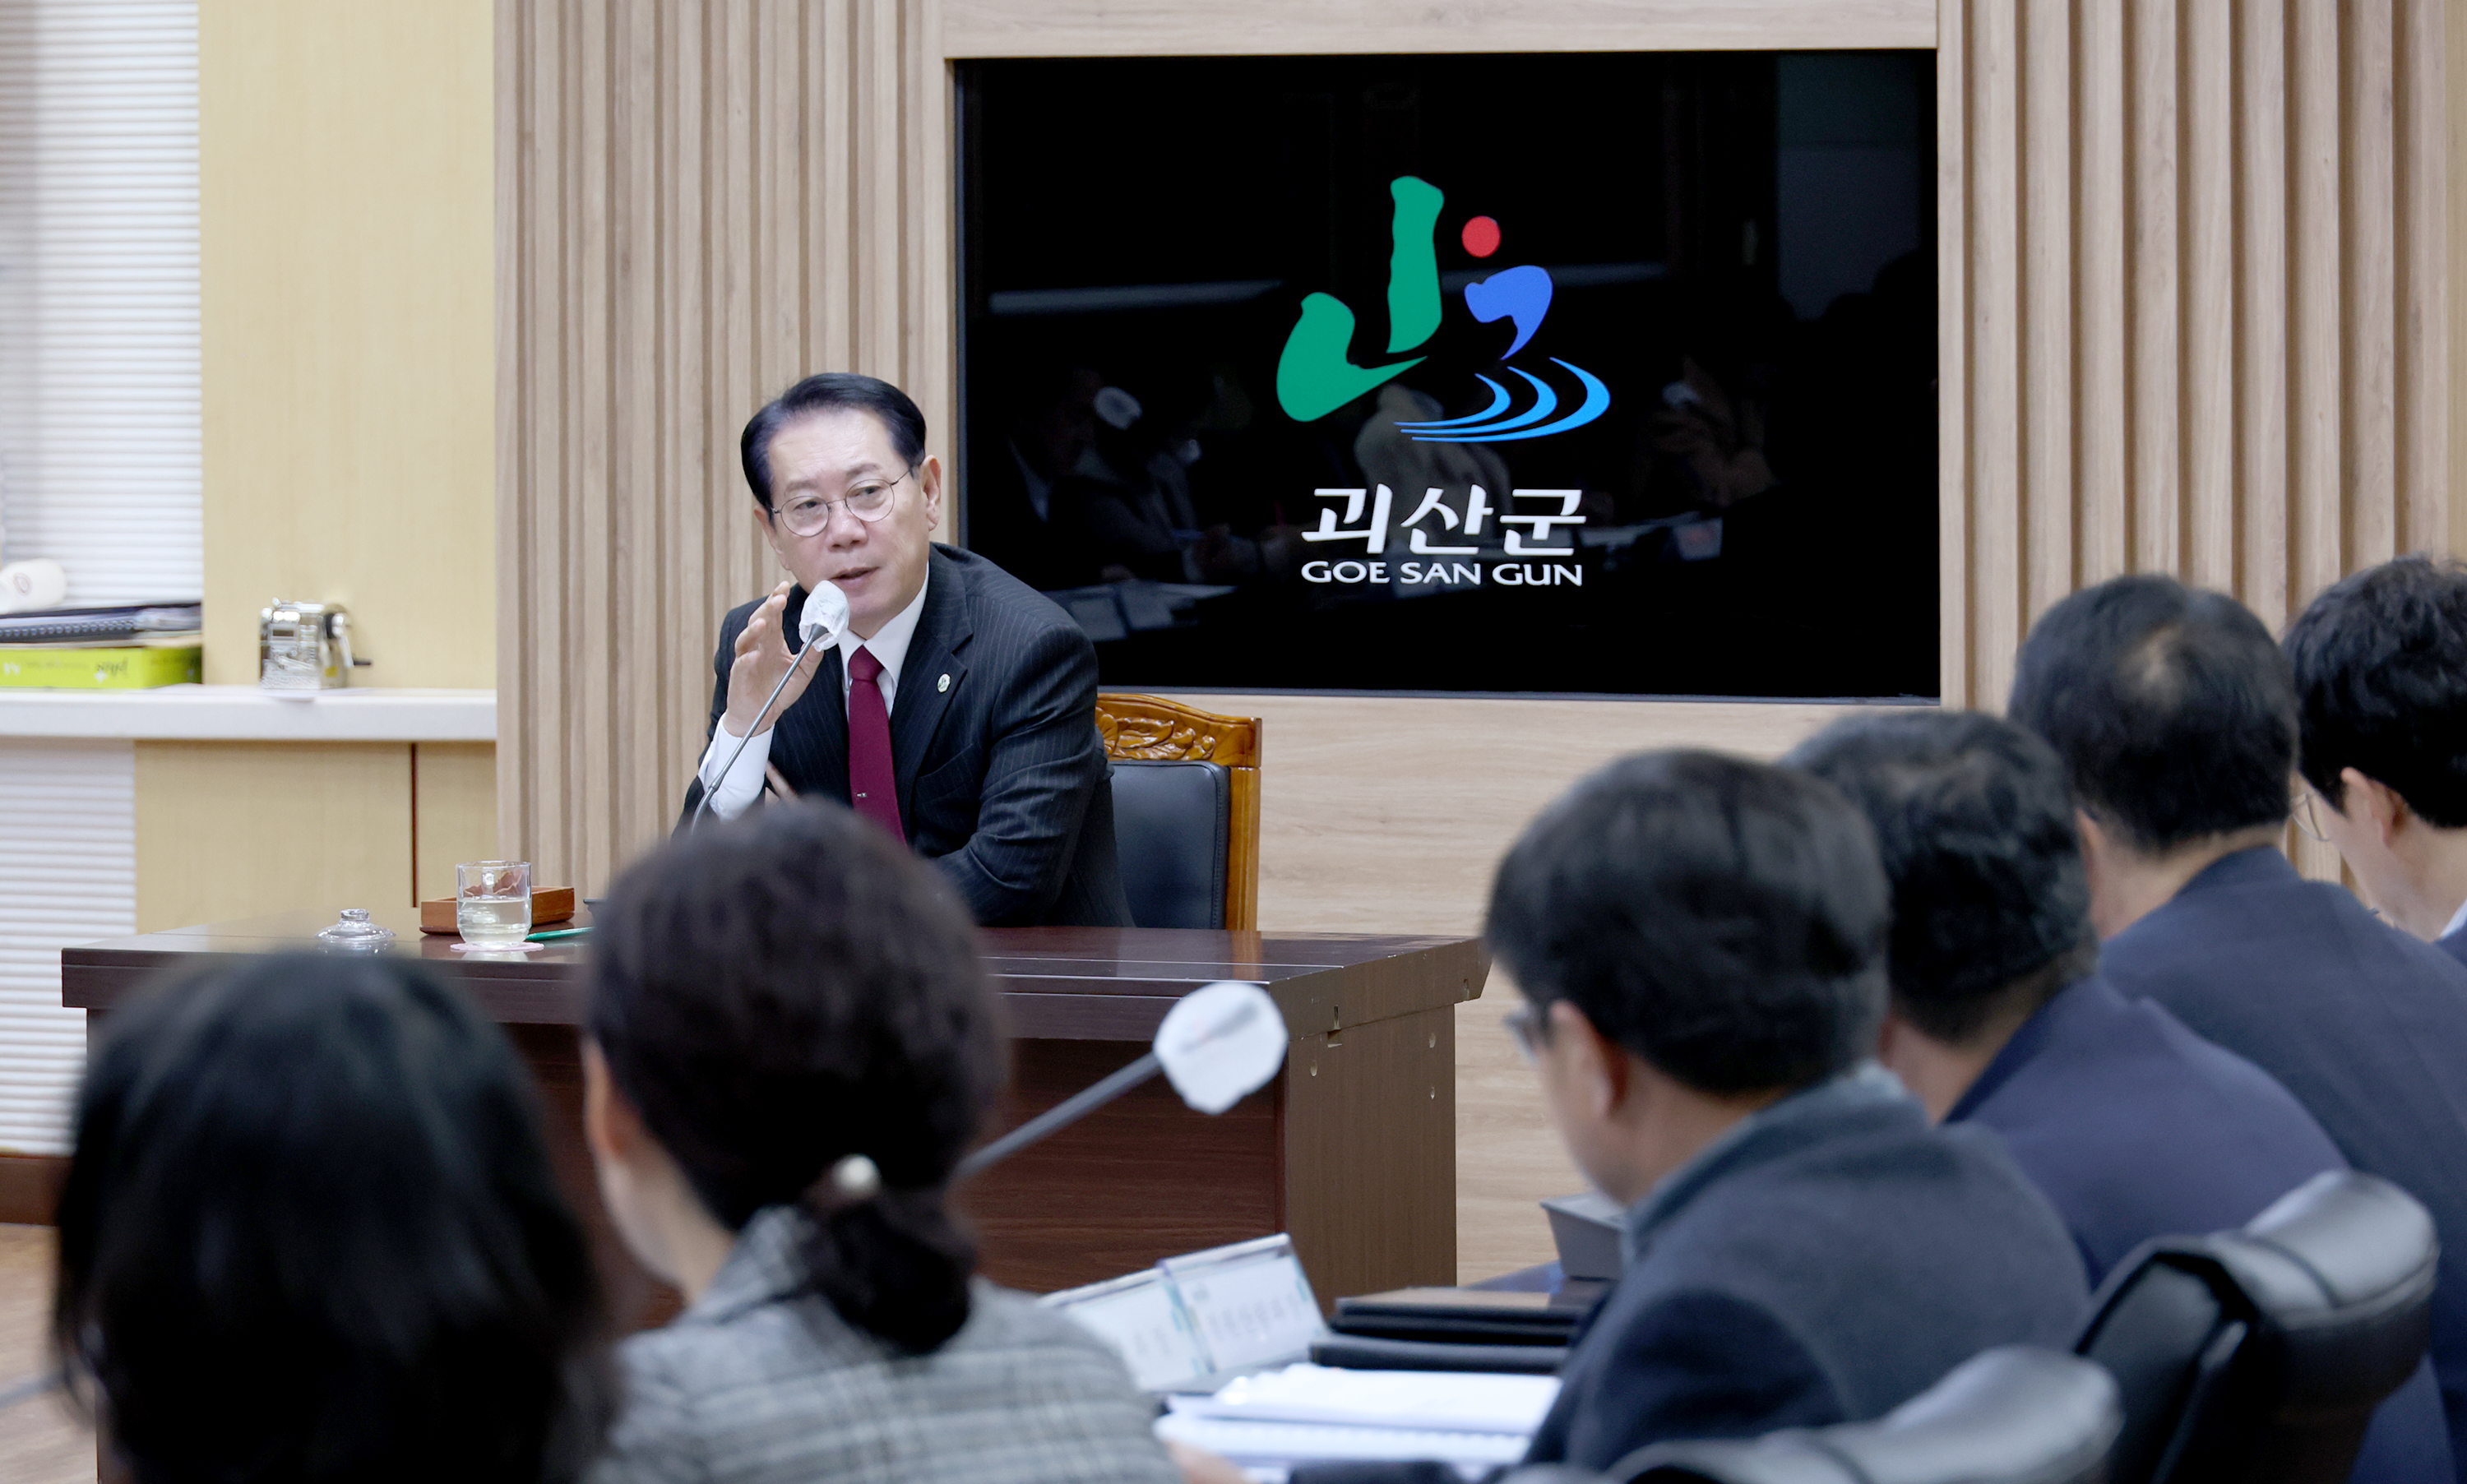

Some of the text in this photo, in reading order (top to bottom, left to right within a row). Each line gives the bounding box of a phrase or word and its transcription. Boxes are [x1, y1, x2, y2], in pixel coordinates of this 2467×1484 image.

[1301, 483, 1586, 556] 괴산군
[1301, 561, 1582, 586] GOE SAN GUN
